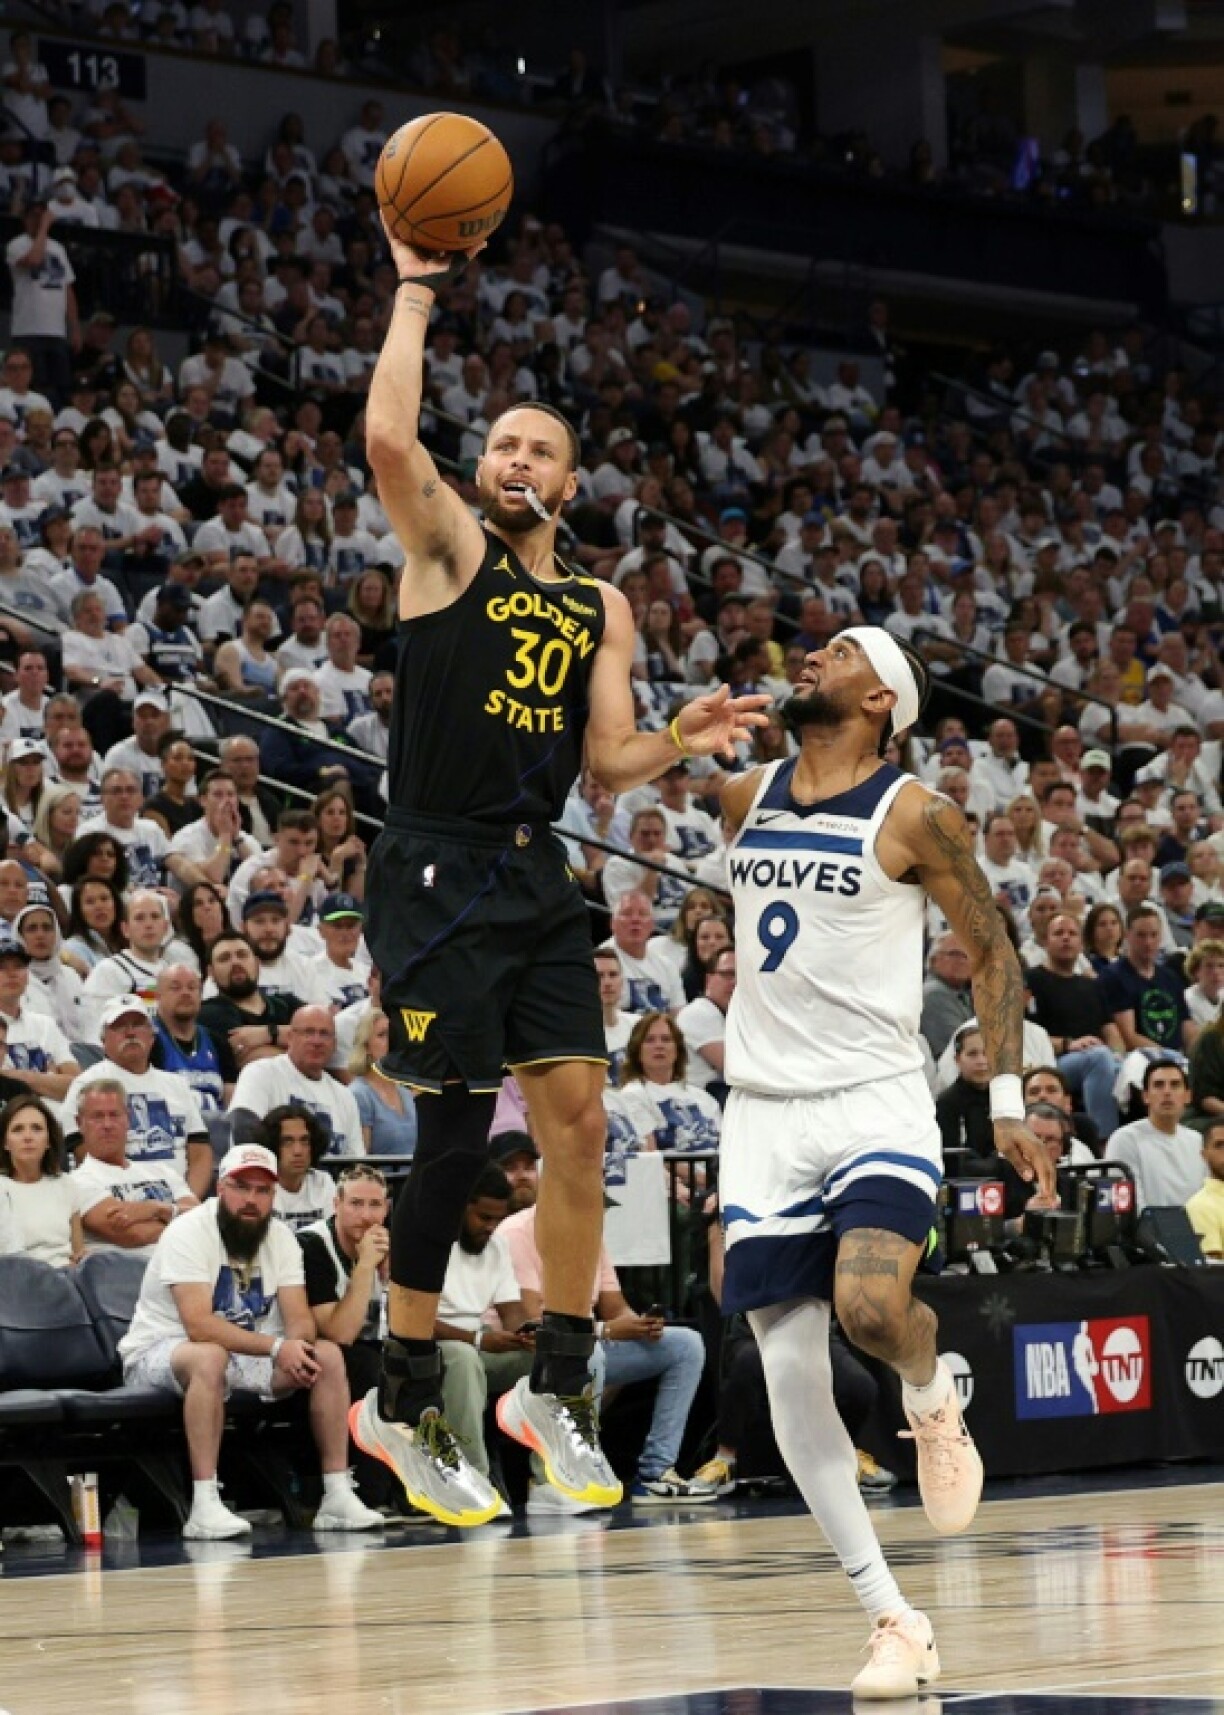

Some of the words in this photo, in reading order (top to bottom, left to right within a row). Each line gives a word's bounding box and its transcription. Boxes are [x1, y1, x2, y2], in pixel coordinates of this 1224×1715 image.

[66, 53, 119, 87] 113
[487, 592, 594, 659] GOLDEN
[506, 628, 572, 695] 30
[485, 690, 564, 733] STATE
[730, 859, 863, 896] WOLVES
[757, 900, 799, 972] 9
[1025, 1342, 1071, 1398] NBA
